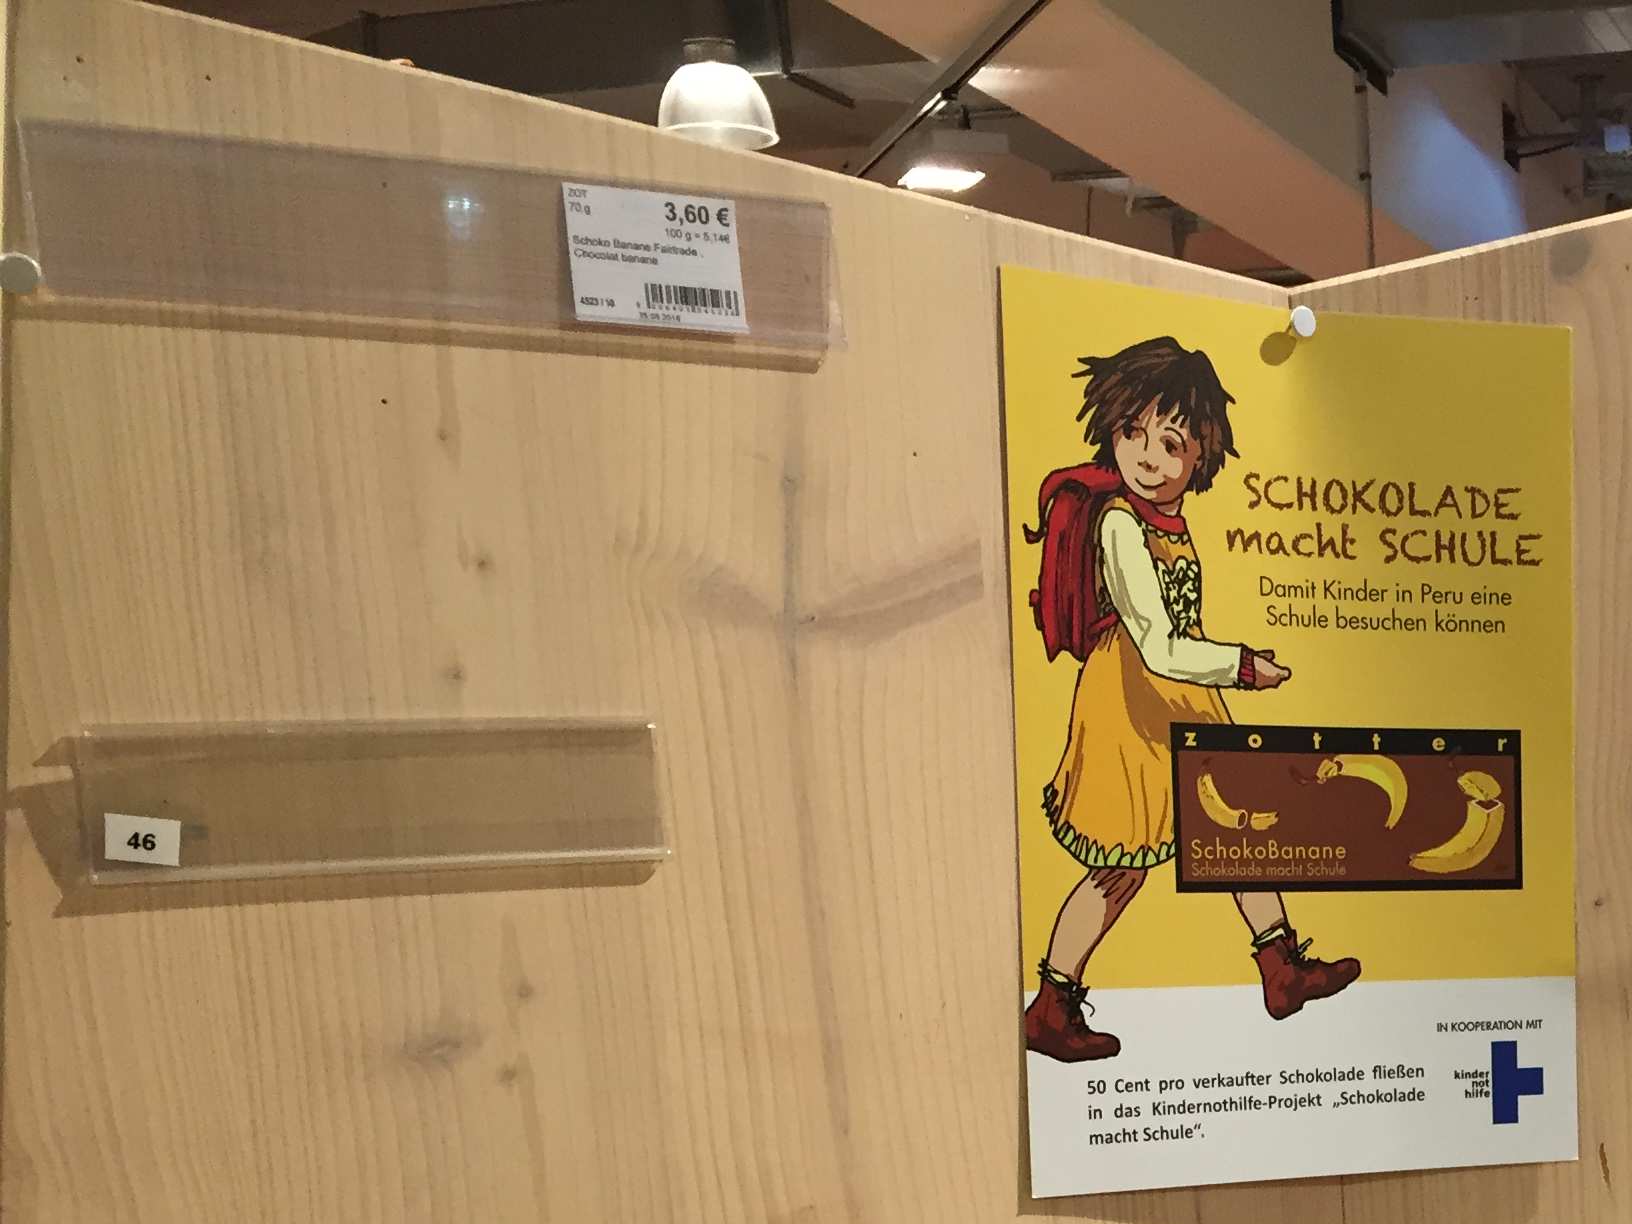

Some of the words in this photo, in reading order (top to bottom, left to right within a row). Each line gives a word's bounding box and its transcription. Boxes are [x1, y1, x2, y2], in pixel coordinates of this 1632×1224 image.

[568, 202, 581, 213] 70
[583, 206, 591, 215] g
[664, 202, 710, 225] 3,60
[716, 208, 730, 227] €
[572, 235, 611, 248] Schoko
[1243, 472, 1522, 520] SCHOKOLADE
[1225, 522, 1357, 560] macht
[1379, 527, 1543, 566] SCHULE
[1259, 576, 1316, 598] Damit
[1323, 578, 1388, 602] Kinder
[1396, 581, 1412, 603] in
[1420, 583, 1463, 605] Peru
[1471, 585, 1512, 606] eine
[1266, 604, 1328, 629] Schule
[1335, 604, 1427, 632] besuchen
[1435, 609, 1505, 633] können
[127, 832, 156, 851] 46
[1191, 839, 1347, 860] SchokoBanane
[1192, 863, 1263, 877] Schokolade
[1266, 863, 1303, 877] macht
[1306, 862, 1347, 876] Schule
[1436, 1022, 1448, 1033] IN
[1451, 1019, 1523, 1032] KOOPERATION
[1526, 1018, 1543, 1029] MIT
[1087, 1080, 1107, 1095] 50
[1114, 1078, 1151, 1094] Cent
[1159, 1079, 1185, 1095] pro
[1193, 1071, 1272, 1090] verkaufter
[1279, 1065, 1365, 1085] Schokolade
[1372, 1064, 1425, 1081] fließen
[1454, 1069, 1490, 1080] kinder
[1472, 1079, 1489, 1088] not
[1088, 1105, 1103, 1120] in
[1113, 1102, 1141, 1119] das
[1152, 1092, 1323, 1117] Kindernothilfe-Projekt
[1333, 1087, 1426, 1109] „Schokolade
[1464, 1089, 1490, 1098] hilfe
[1089, 1126, 1139, 1146] macht
